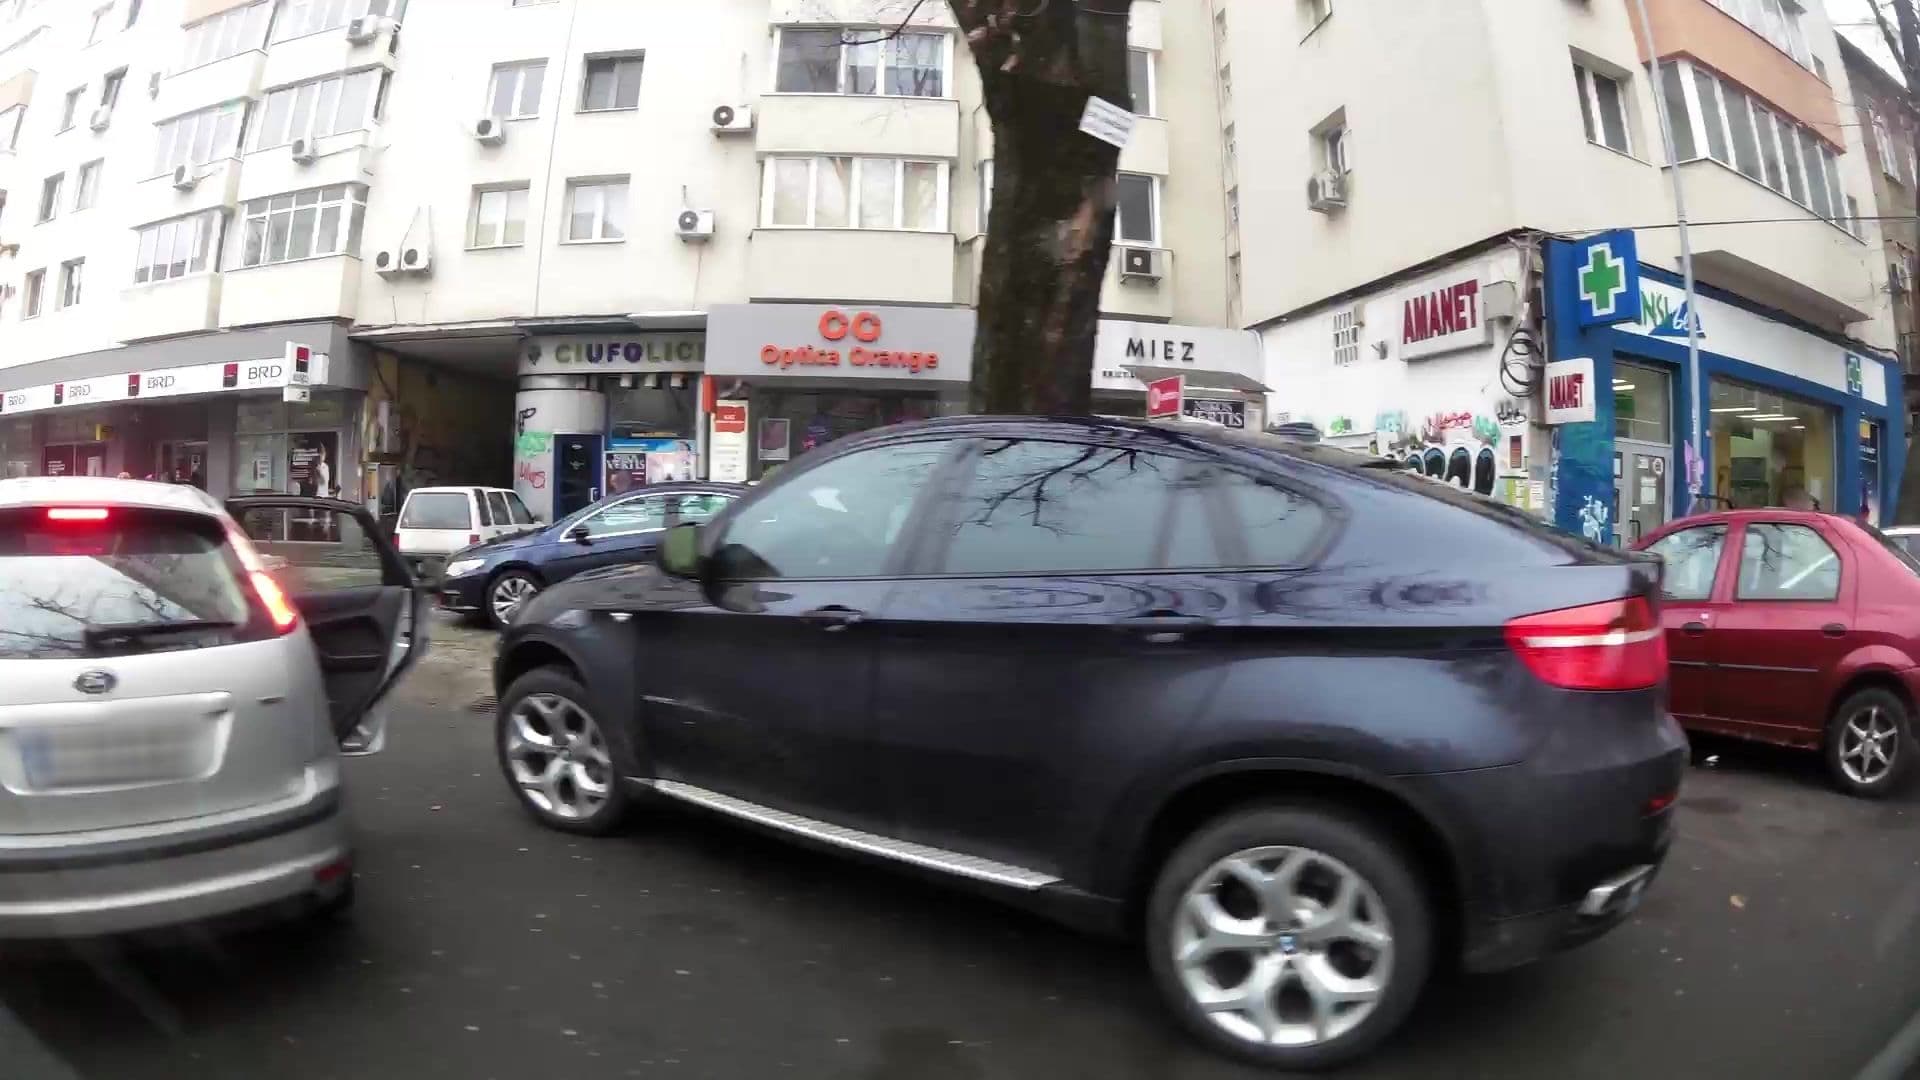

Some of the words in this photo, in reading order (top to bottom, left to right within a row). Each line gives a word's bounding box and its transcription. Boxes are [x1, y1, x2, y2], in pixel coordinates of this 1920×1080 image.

[1403, 279, 1477, 344] AMANET
[1126, 337, 1195, 361] MIEZ
[760, 345, 840, 370] Optica
[849, 346, 939, 373] Orange
[147, 376, 175, 388] BRD
[247, 366, 282, 379] BRD
[69, 384, 91, 398] BRD
